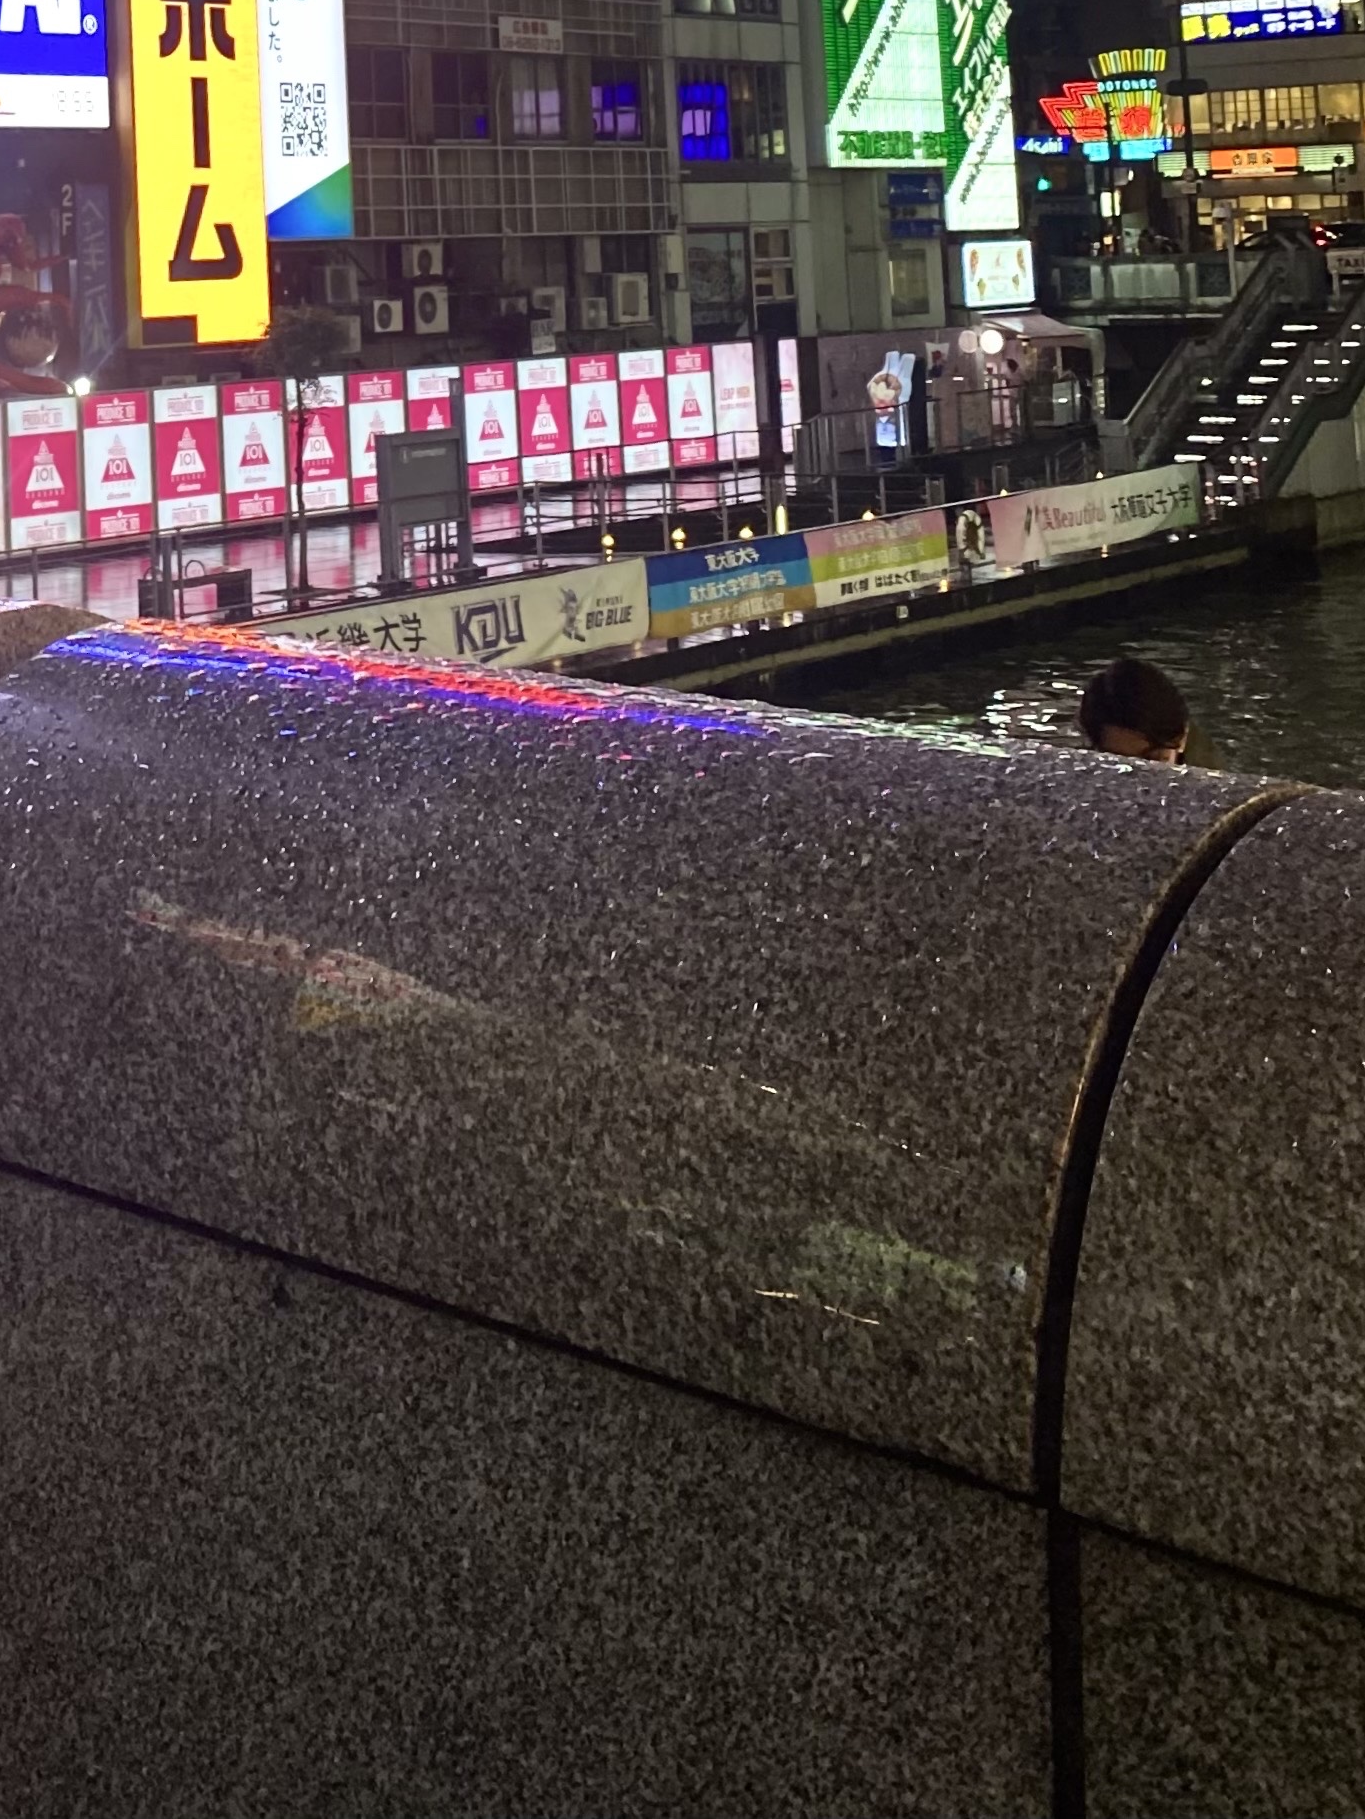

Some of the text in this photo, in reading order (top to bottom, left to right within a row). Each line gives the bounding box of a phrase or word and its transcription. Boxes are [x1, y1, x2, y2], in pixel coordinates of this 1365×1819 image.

[1020, 137, 1064, 154] Asahi
[61, 184, 73, 236] 2F
[179, 452, 197, 467] 101
[246, 446, 263, 460] 101
[35, 467, 54, 482] 101
[108, 458, 127, 475] 101
[705, 546, 760, 572] 東大阪大学
[586, 605, 632, 630] BIG BLUE
